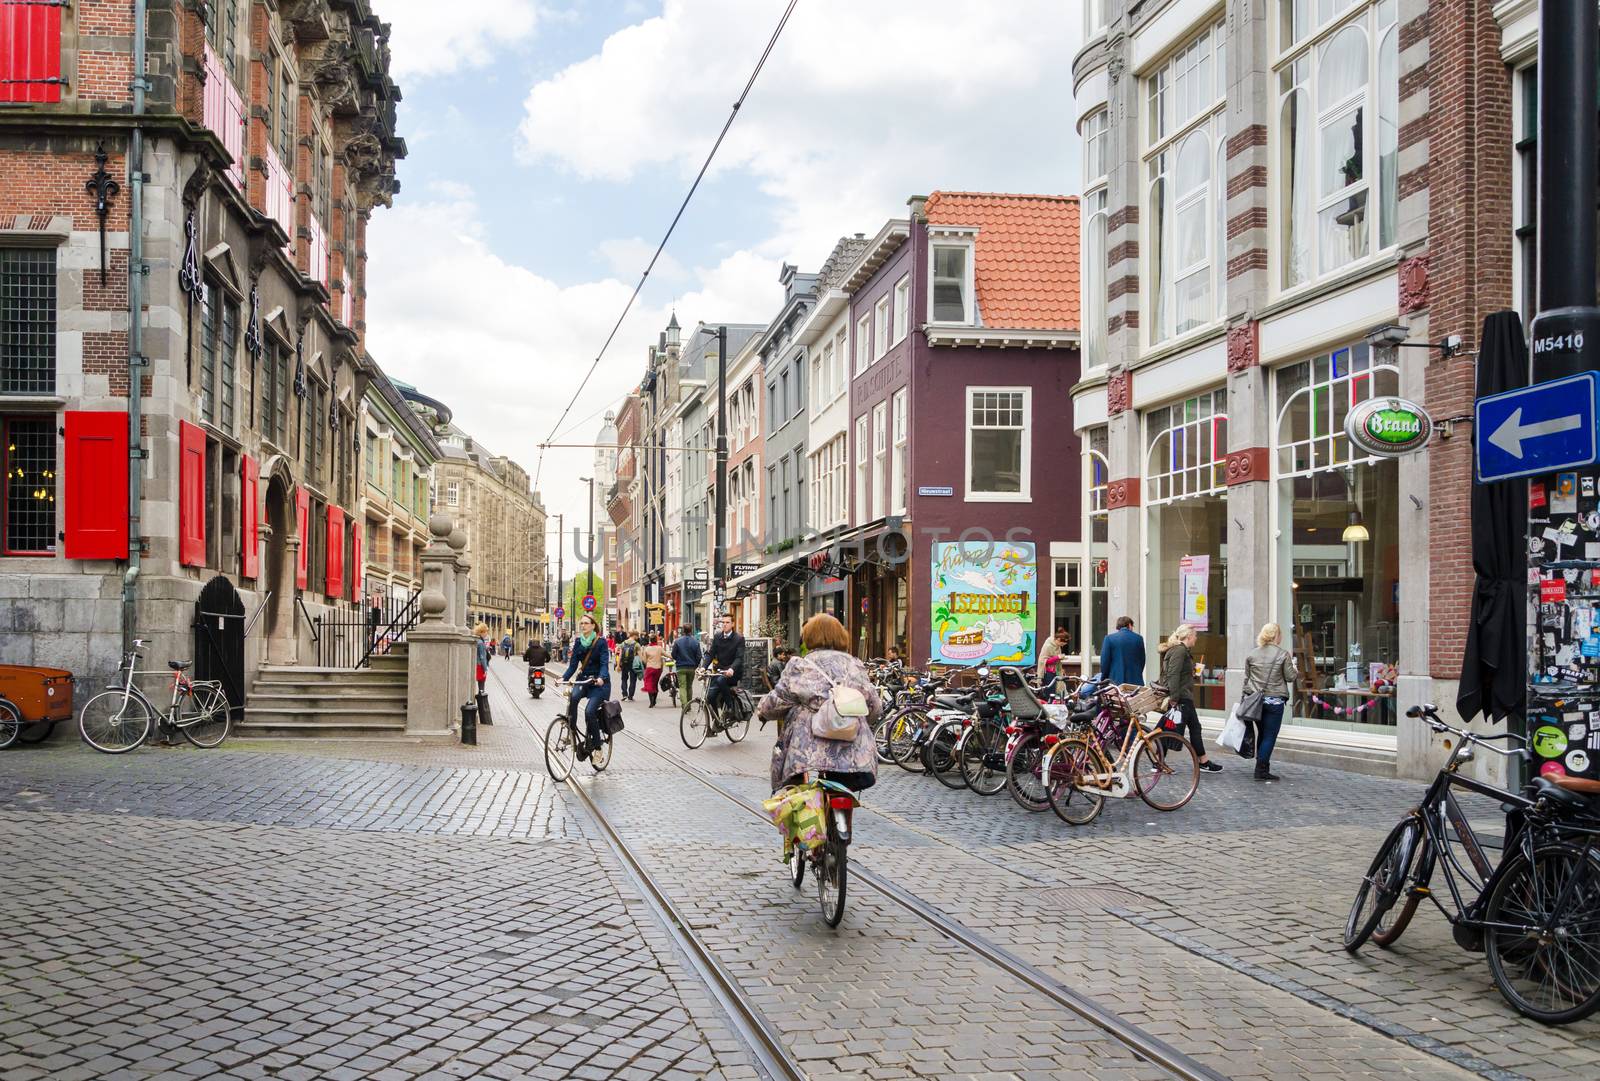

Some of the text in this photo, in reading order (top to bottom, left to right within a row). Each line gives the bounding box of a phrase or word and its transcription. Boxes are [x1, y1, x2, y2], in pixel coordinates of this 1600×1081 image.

[1534, 334, 1584, 354] M5410
[1371, 412, 1420, 434] Brand
[956, 635, 976, 645] EAT
